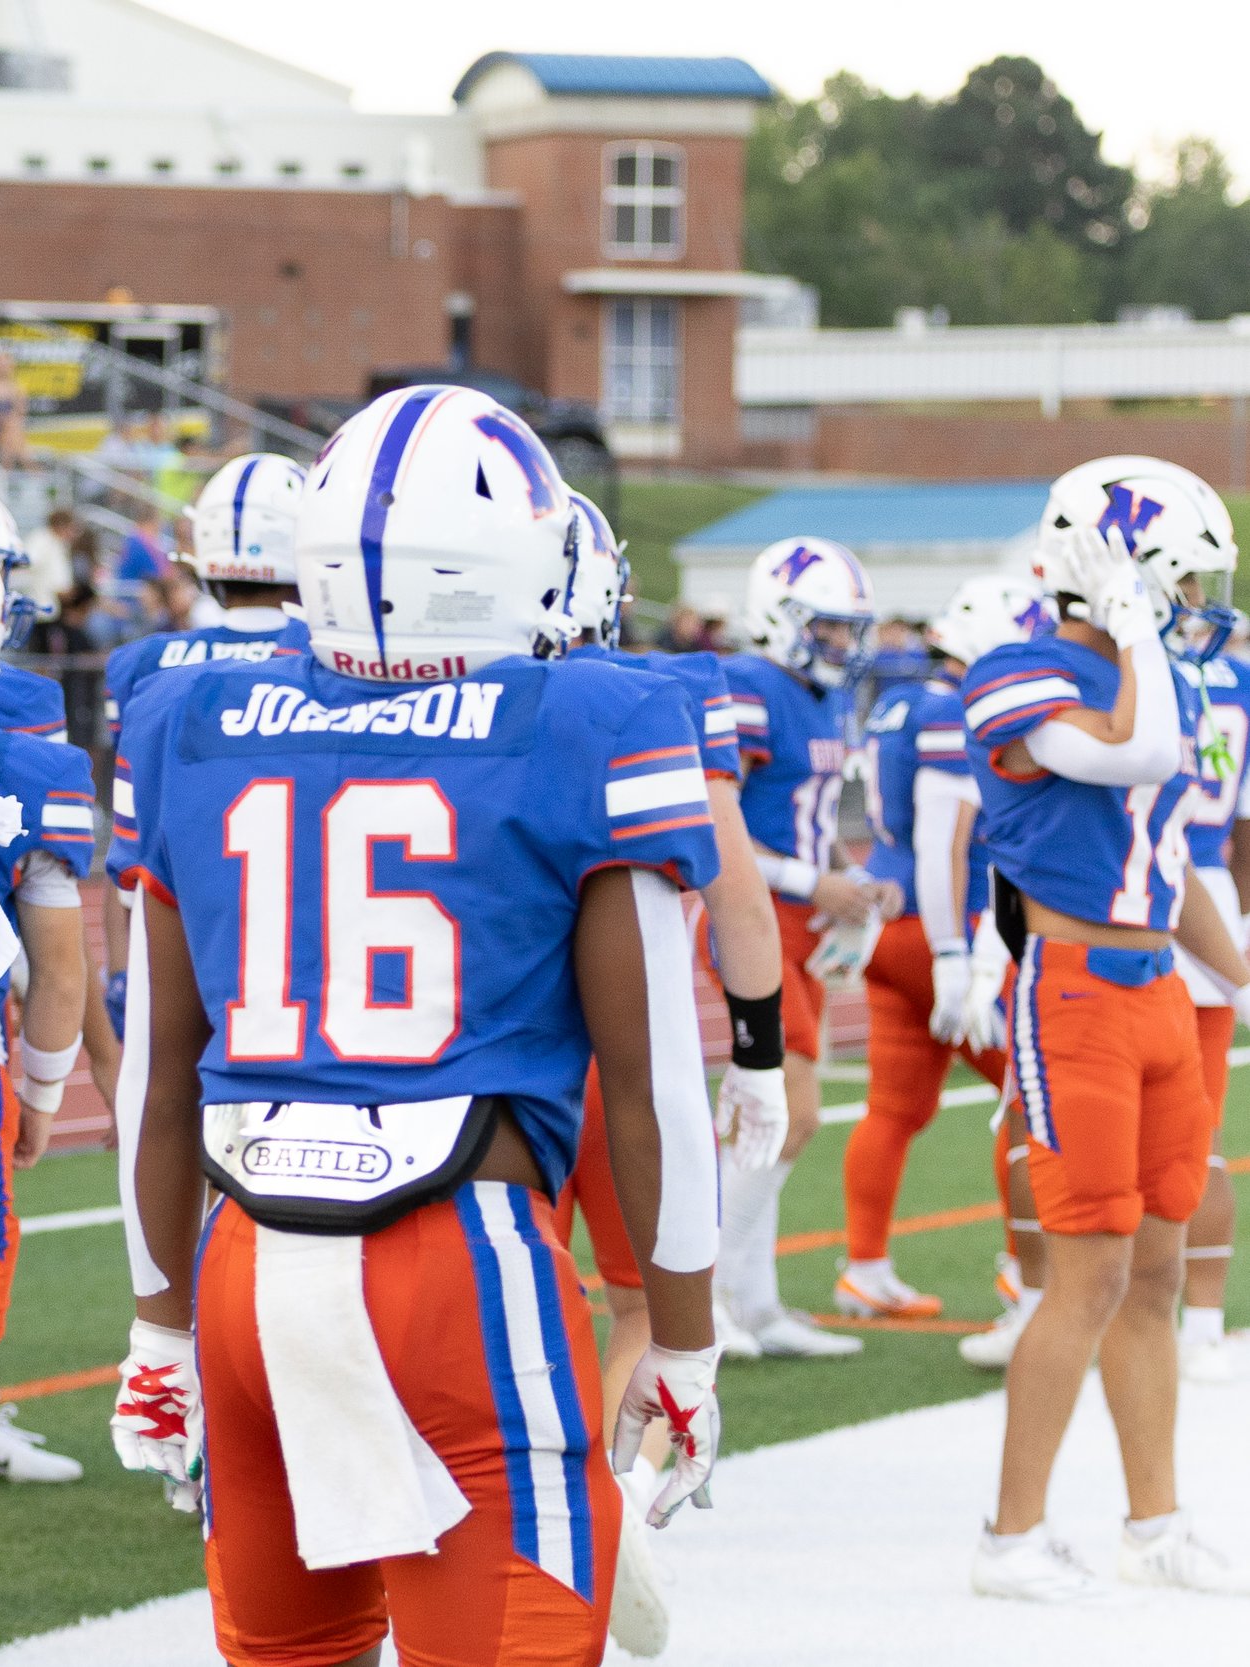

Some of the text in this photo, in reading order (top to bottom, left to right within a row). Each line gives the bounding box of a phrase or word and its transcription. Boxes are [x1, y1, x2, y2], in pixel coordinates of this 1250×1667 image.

[332, 651, 467, 680] Riddell
[220, 682, 504, 739] JOHNSON
[223, 777, 462, 1064] 16
[253, 1146, 378, 1174] BATTLE
